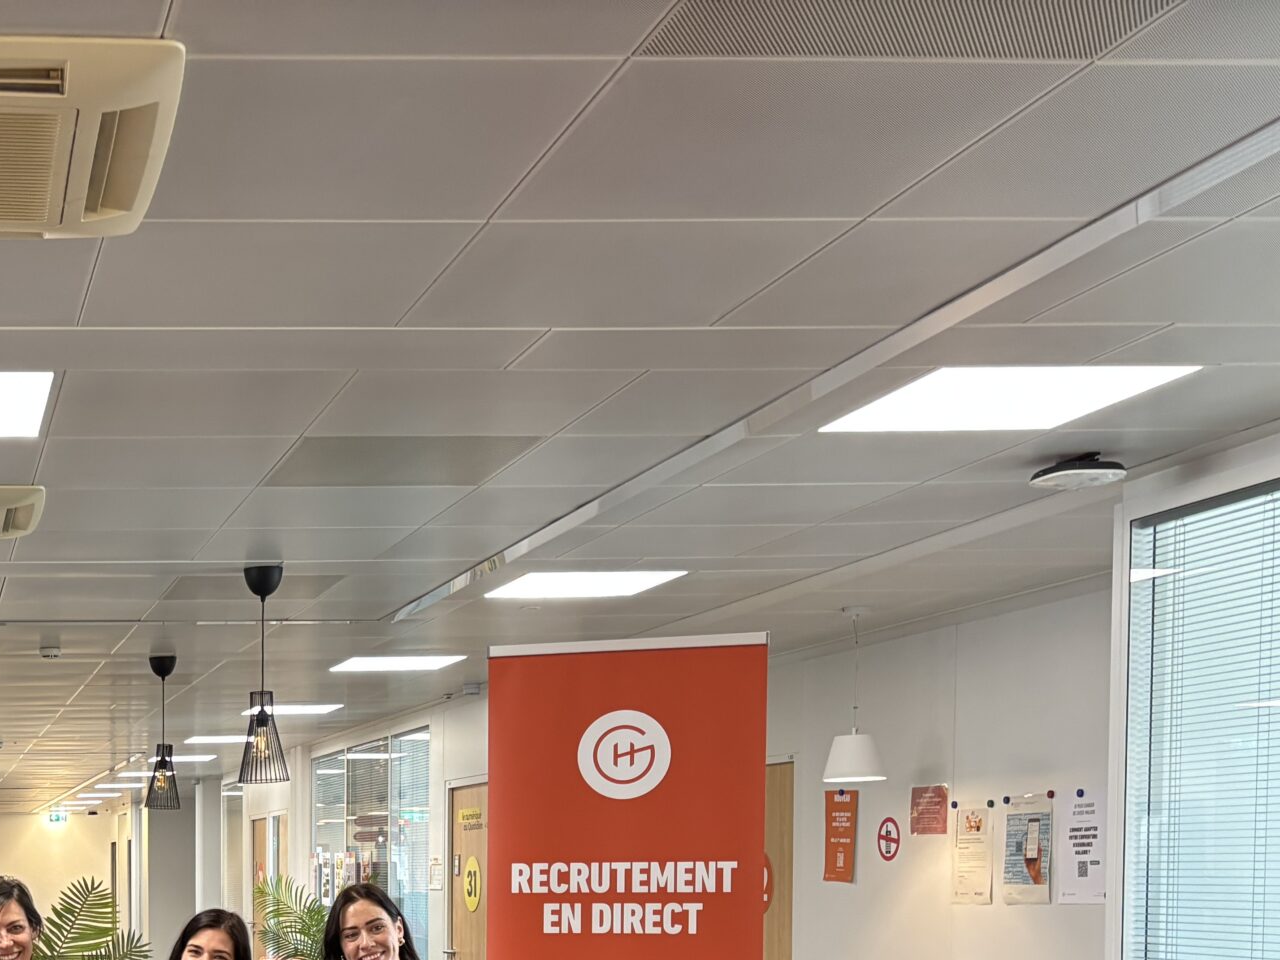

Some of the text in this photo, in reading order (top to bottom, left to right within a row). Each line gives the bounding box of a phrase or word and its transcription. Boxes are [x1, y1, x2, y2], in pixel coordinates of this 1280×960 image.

[466, 870, 477, 898] 31
[510, 860, 739, 894] RECRUTEMENT
[543, 902, 704, 935] EN DIRECT
